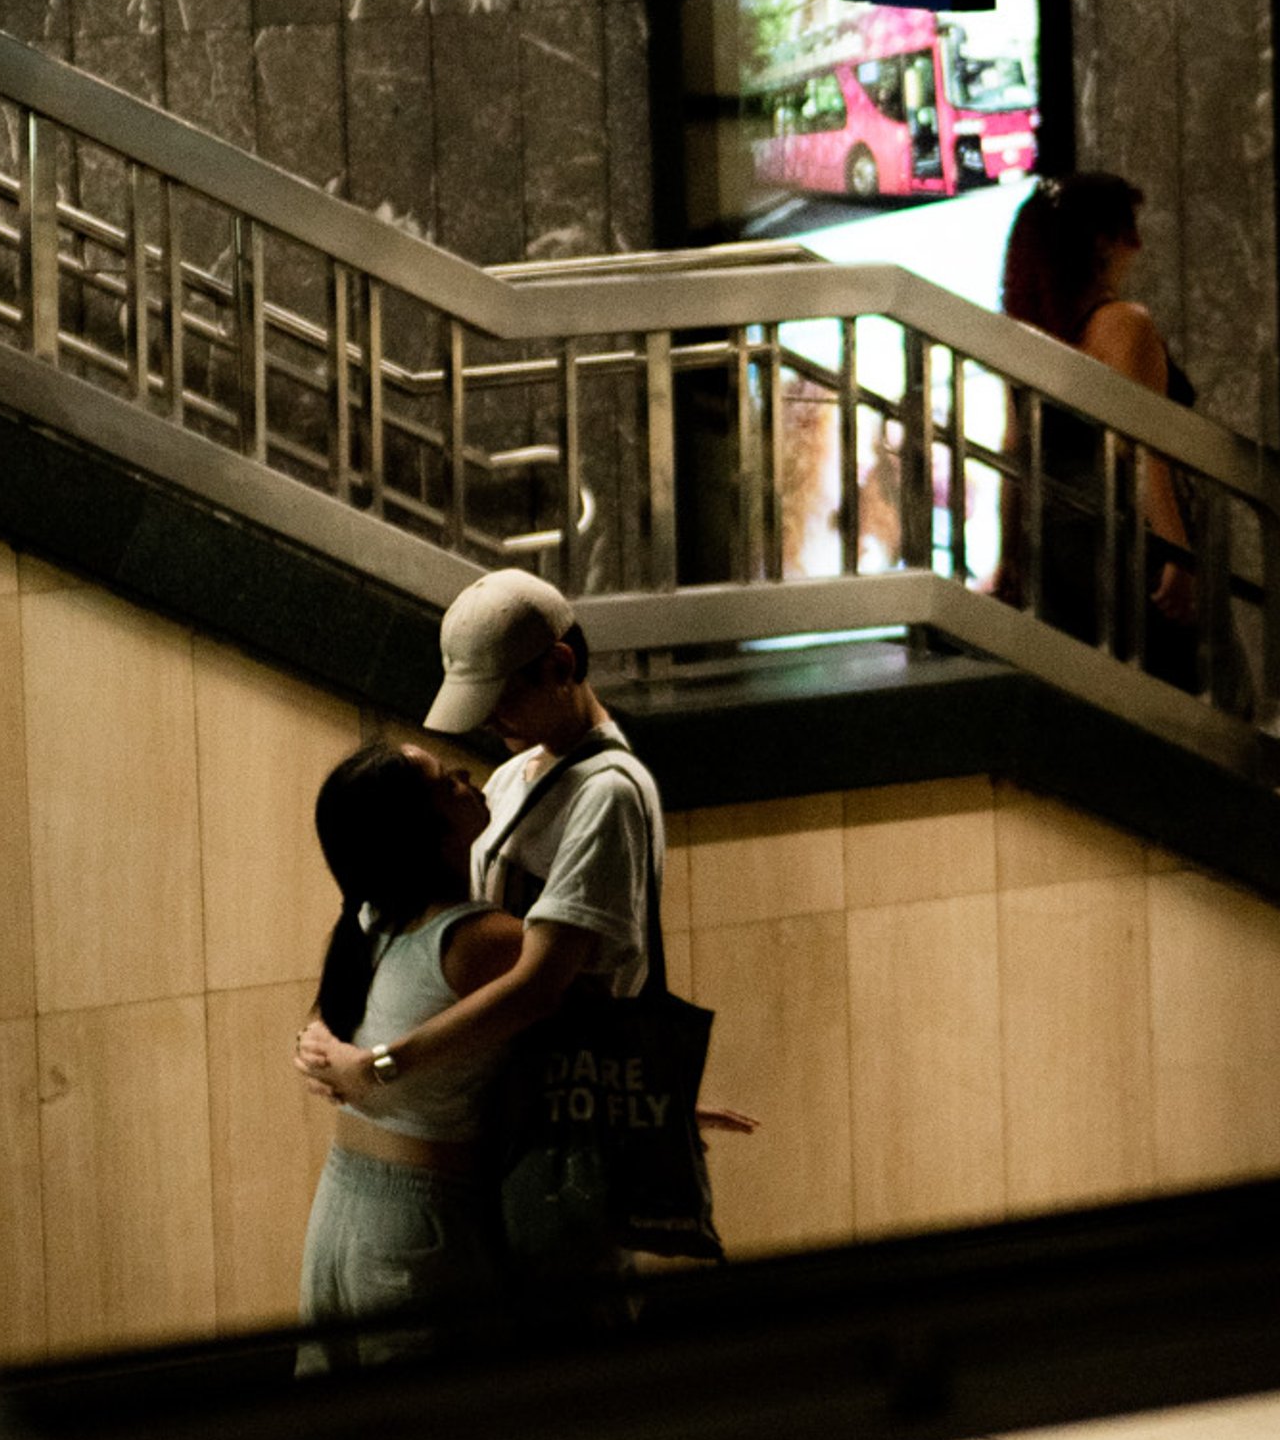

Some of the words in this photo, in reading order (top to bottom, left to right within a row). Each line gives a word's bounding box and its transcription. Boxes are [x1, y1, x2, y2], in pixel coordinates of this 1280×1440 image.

[544, 1049, 646, 1091] DARE
[544, 1086, 596, 1123] TO
[605, 1093, 671, 1129] FLY
